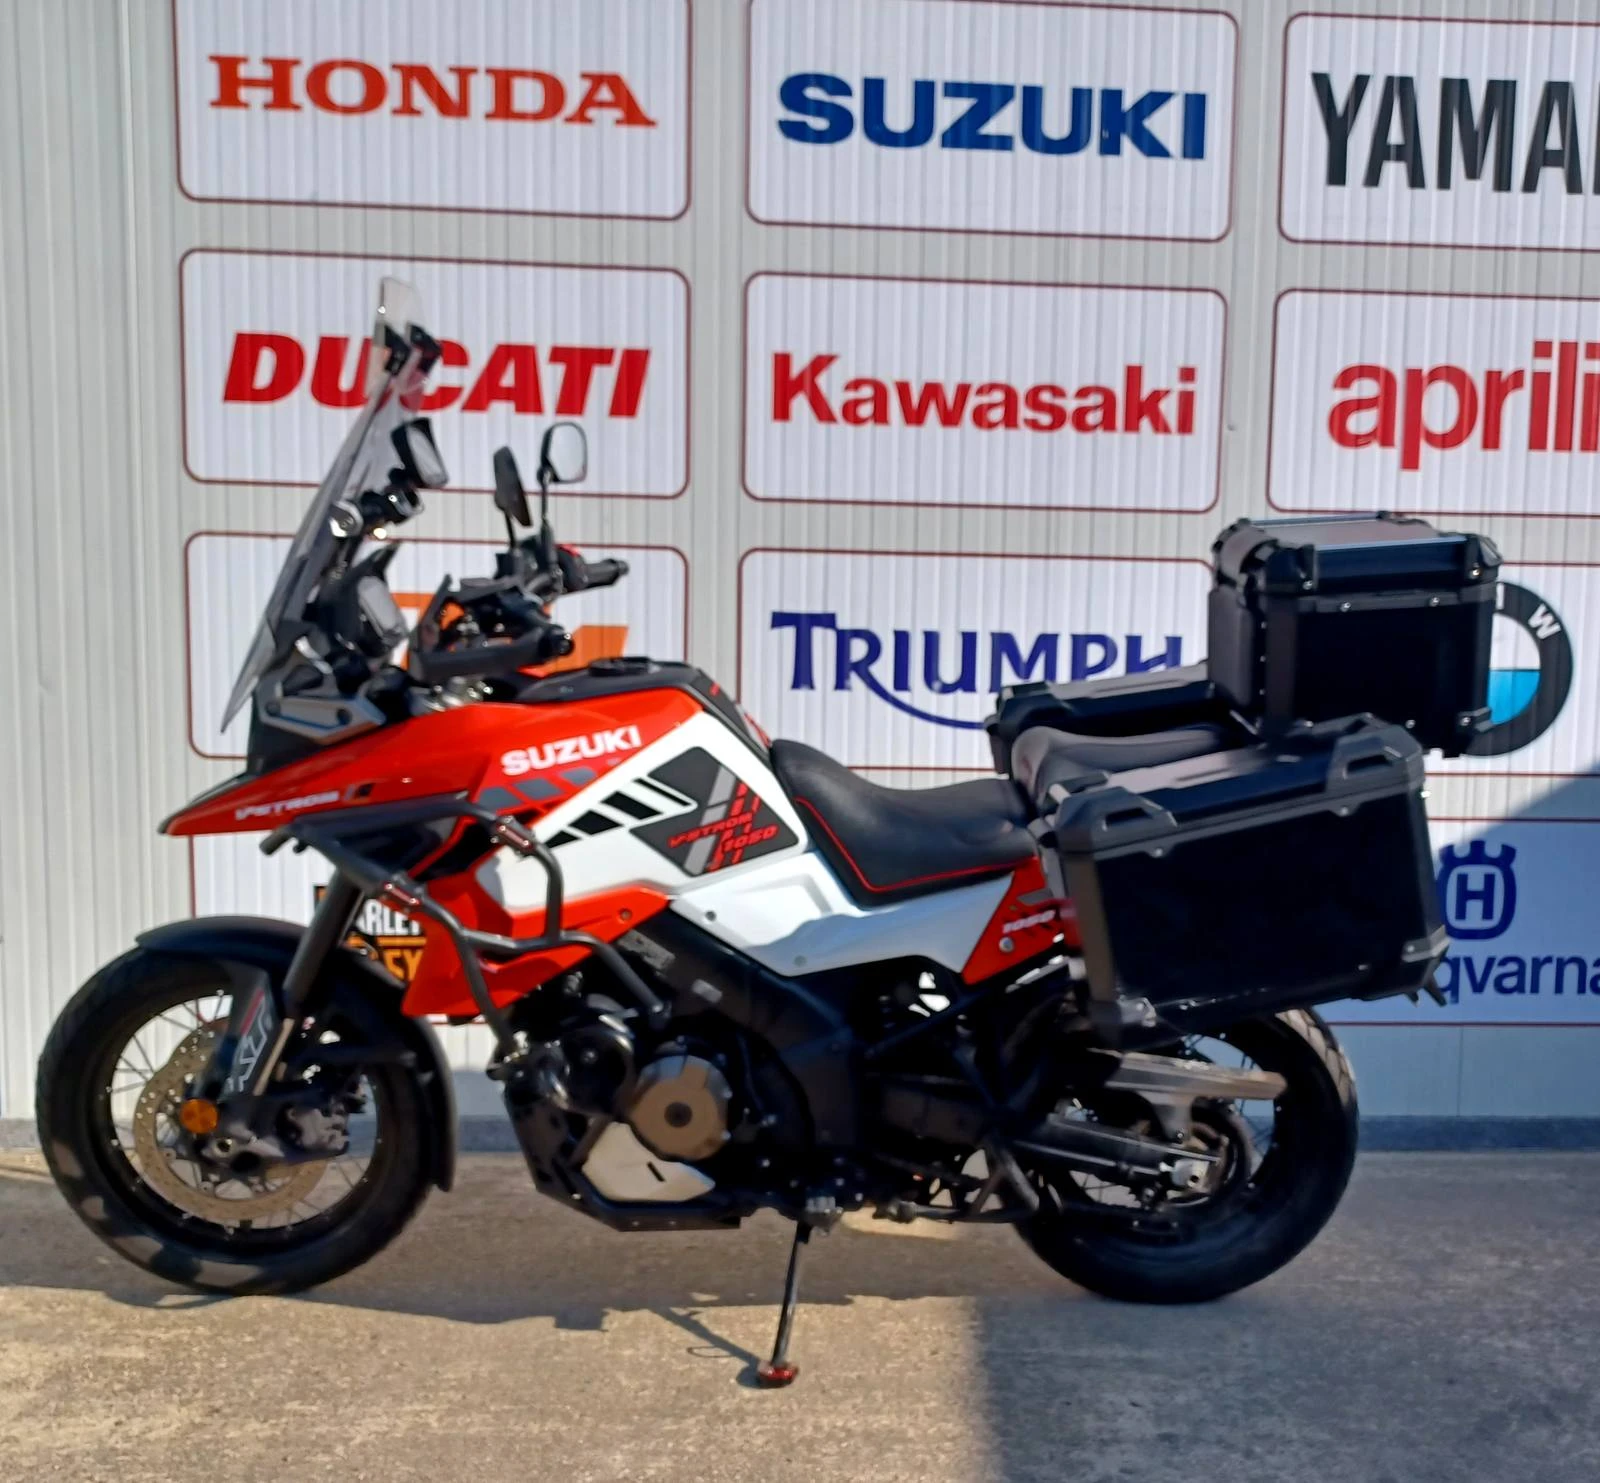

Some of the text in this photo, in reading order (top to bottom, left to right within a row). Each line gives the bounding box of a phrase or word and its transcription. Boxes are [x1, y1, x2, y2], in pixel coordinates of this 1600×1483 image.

[208, 55, 658, 128] HONDA
[777, 71, 1207, 161] SUZUKI
[222, 332, 652, 419] DUCATI
[771, 351, 1197, 436] Kawasaki
[501, 724, 642, 776] SUZUKI
